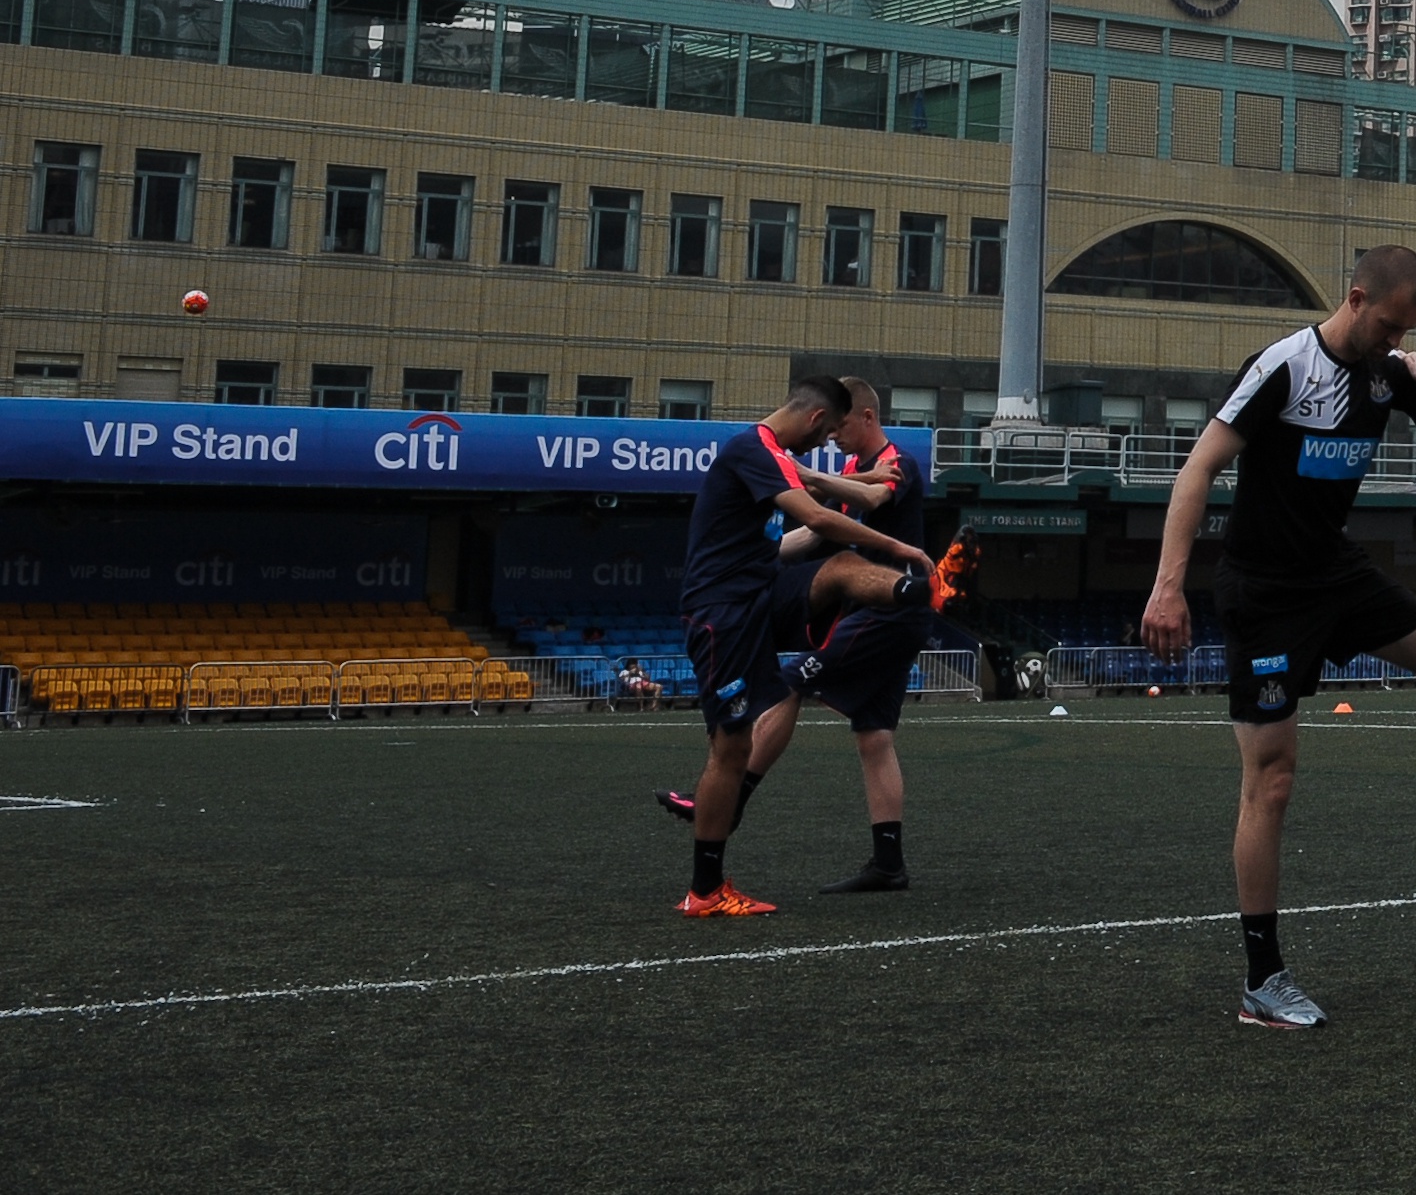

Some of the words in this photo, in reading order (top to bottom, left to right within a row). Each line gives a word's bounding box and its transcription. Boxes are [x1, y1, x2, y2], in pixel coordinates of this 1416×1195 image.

[1298, 400, 1326, 418] ST
[84, 421, 158, 458] VIP
[172, 423, 299, 461] Stand
[374, 423, 459, 471] citi
[537, 436, 600, 470] VIP
[611, 437, 718, 472] Stand
[1305, 438, 1373, 466] wonga
[968, 515, 988, 526] THE
[69, 564, 97, 579] VIP
[102, 564, 151, 579] Stand
[175, 556, 234, 586] citi
[260, 565, 287, 580] VIP
[291, 565, 337, 580] Stand
[356, 557, 411, 586] citi
[503, 566, 527, 579] VIP
[530, 566, 572, 579] Stand
[592, 558, 643, 586] citi
[804, 656, 823, 674] 52
